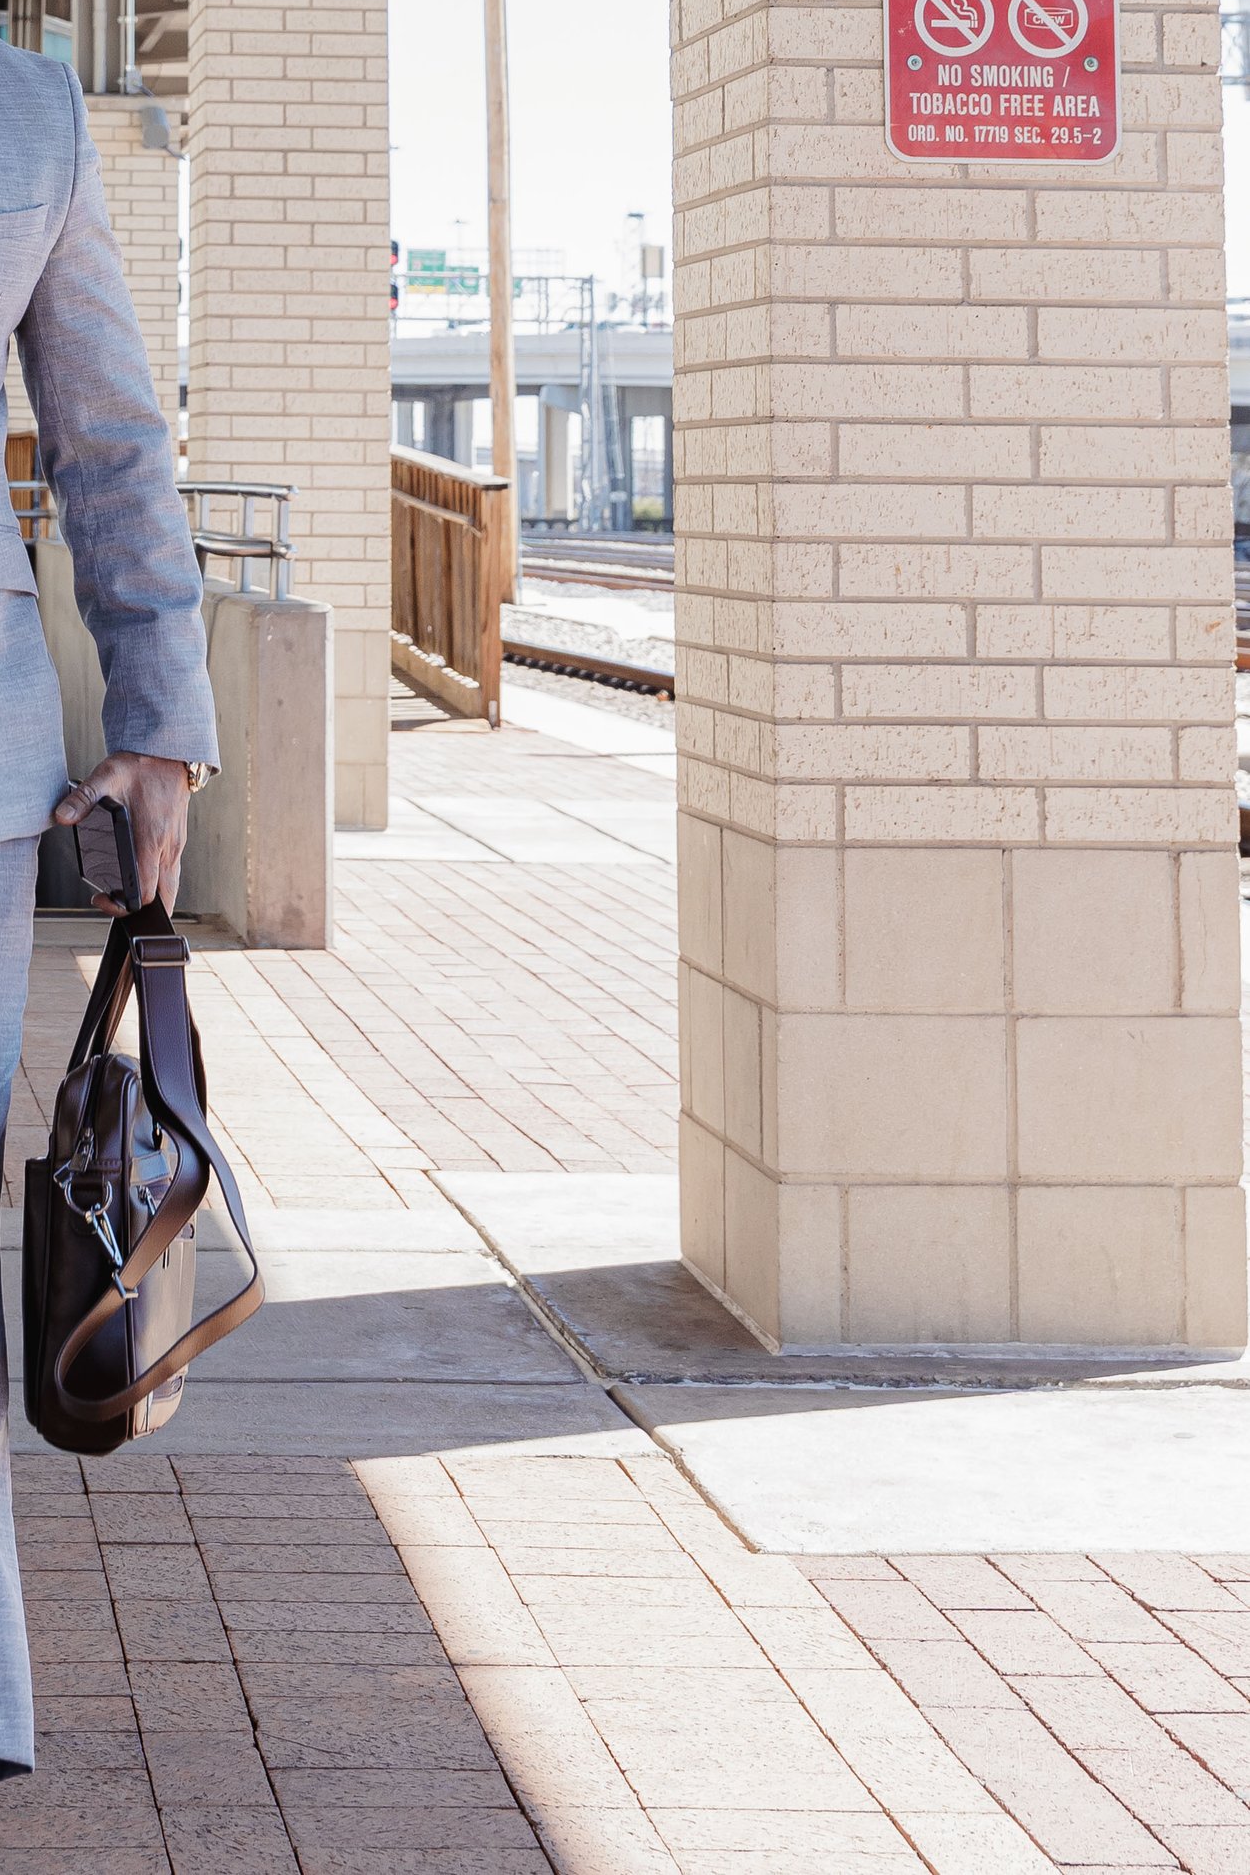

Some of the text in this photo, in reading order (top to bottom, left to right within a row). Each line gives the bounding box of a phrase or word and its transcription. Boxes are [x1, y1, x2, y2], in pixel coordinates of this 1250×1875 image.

[937, 64, 963, 87] NO
[970, 64, 1055, 88] SMOKING
[909, 92, 1101, 118] TOBACCO FREE AREA
[907, 124, 1102, 145] ORD. NO. 17719 SEC. 29.5-2
